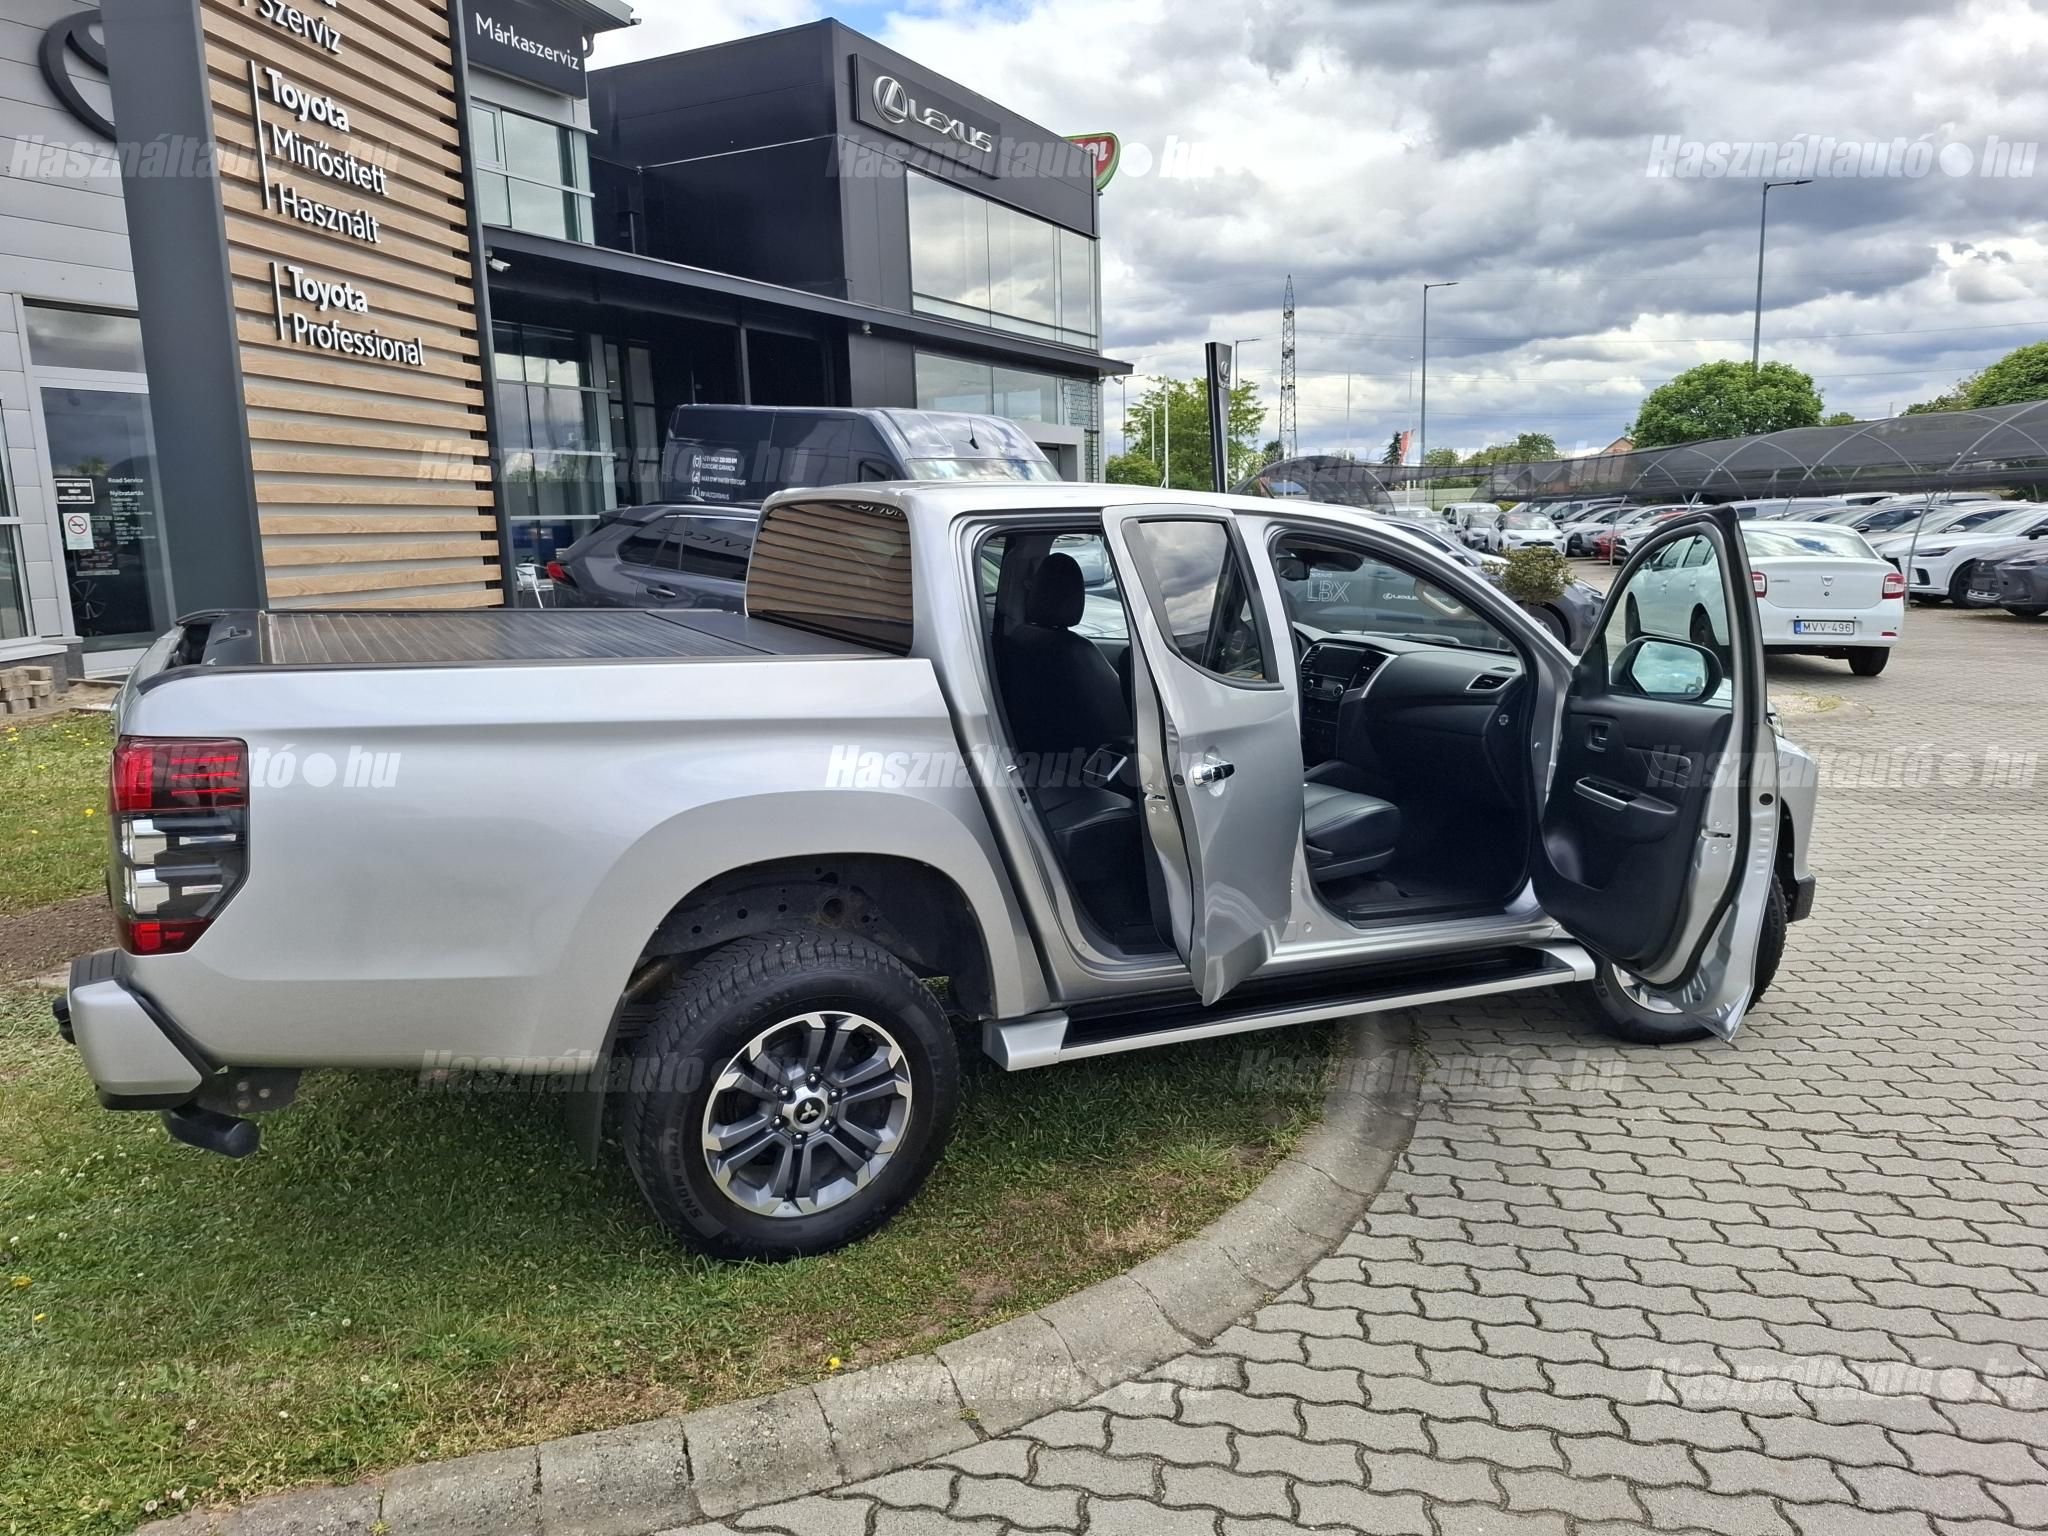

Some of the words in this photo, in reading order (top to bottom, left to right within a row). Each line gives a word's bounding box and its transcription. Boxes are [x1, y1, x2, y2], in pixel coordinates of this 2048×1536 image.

[475, 12, 580, 71] Márkaszerviz
[266, 67, 350, 132] Toyota
[908, 98, 992, 153] LEXUS
[272, 123, 389, 195] Minősített
[279, 182, 381, 243] Használt
[288, 265, 369, 313] Toyota
[293, 312, 426, 367] Professional
[1307, 580, 1350, 602] LBX
[1803, 622, 1851, 633] MVV-496
